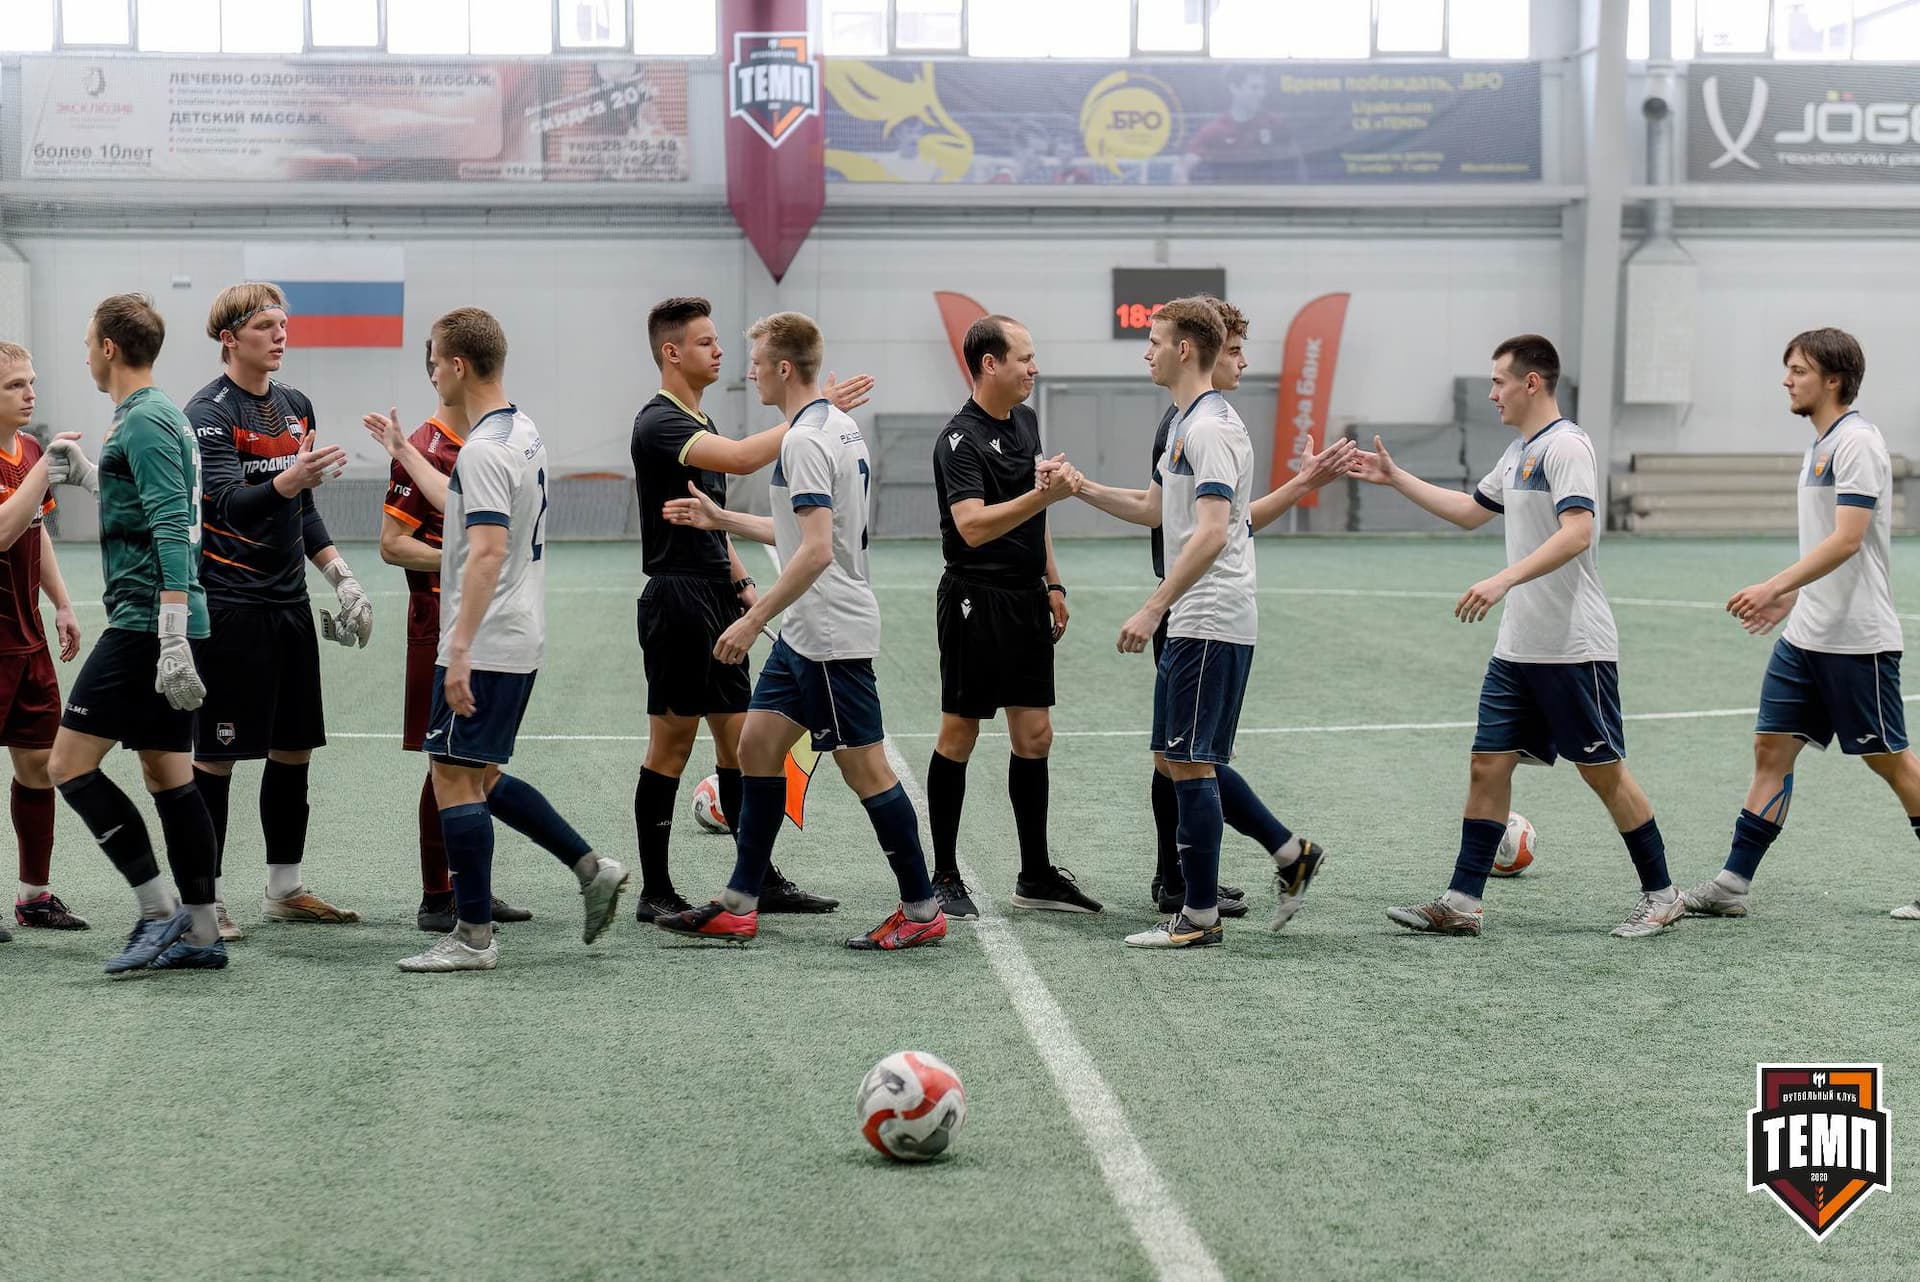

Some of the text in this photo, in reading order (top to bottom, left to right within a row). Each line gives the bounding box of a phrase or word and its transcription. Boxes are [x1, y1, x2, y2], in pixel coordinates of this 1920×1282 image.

[738, 64, 811, 105] ТЕМП
[169, 111, 245, 125] ДЕТСКИЙ
[1106, 110, 1162, 131] .БРО
[1775, 91, 1920, 144] JÖG
[33, 142, 92, 160] более
